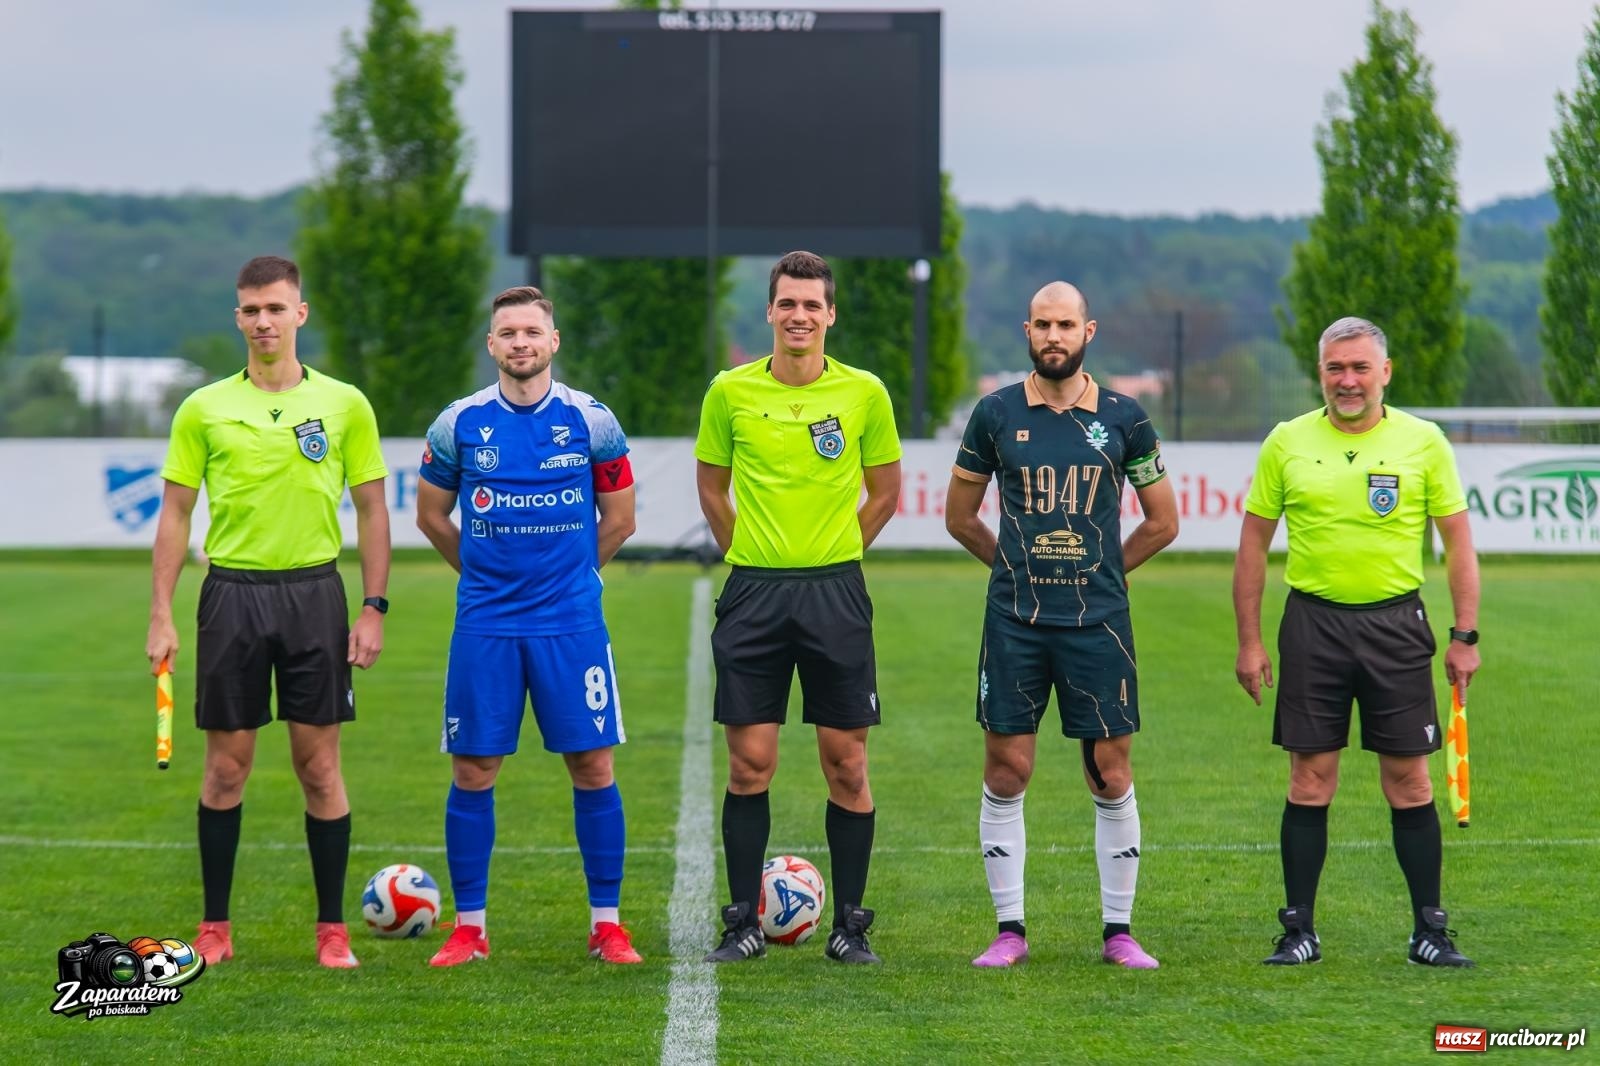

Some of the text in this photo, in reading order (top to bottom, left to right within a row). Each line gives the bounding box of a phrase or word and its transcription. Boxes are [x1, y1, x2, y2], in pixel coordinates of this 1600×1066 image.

[496, 487, 585, 508] Marco Oil
[1020, 465, 1103, 515] 1947
[496, 526, 510, 534] MB
[1030, 546, 1089, 556] AUTO-HANDEL
[584, 665, 609, 712] 8
[1119, 678, 1128, 706] 4
